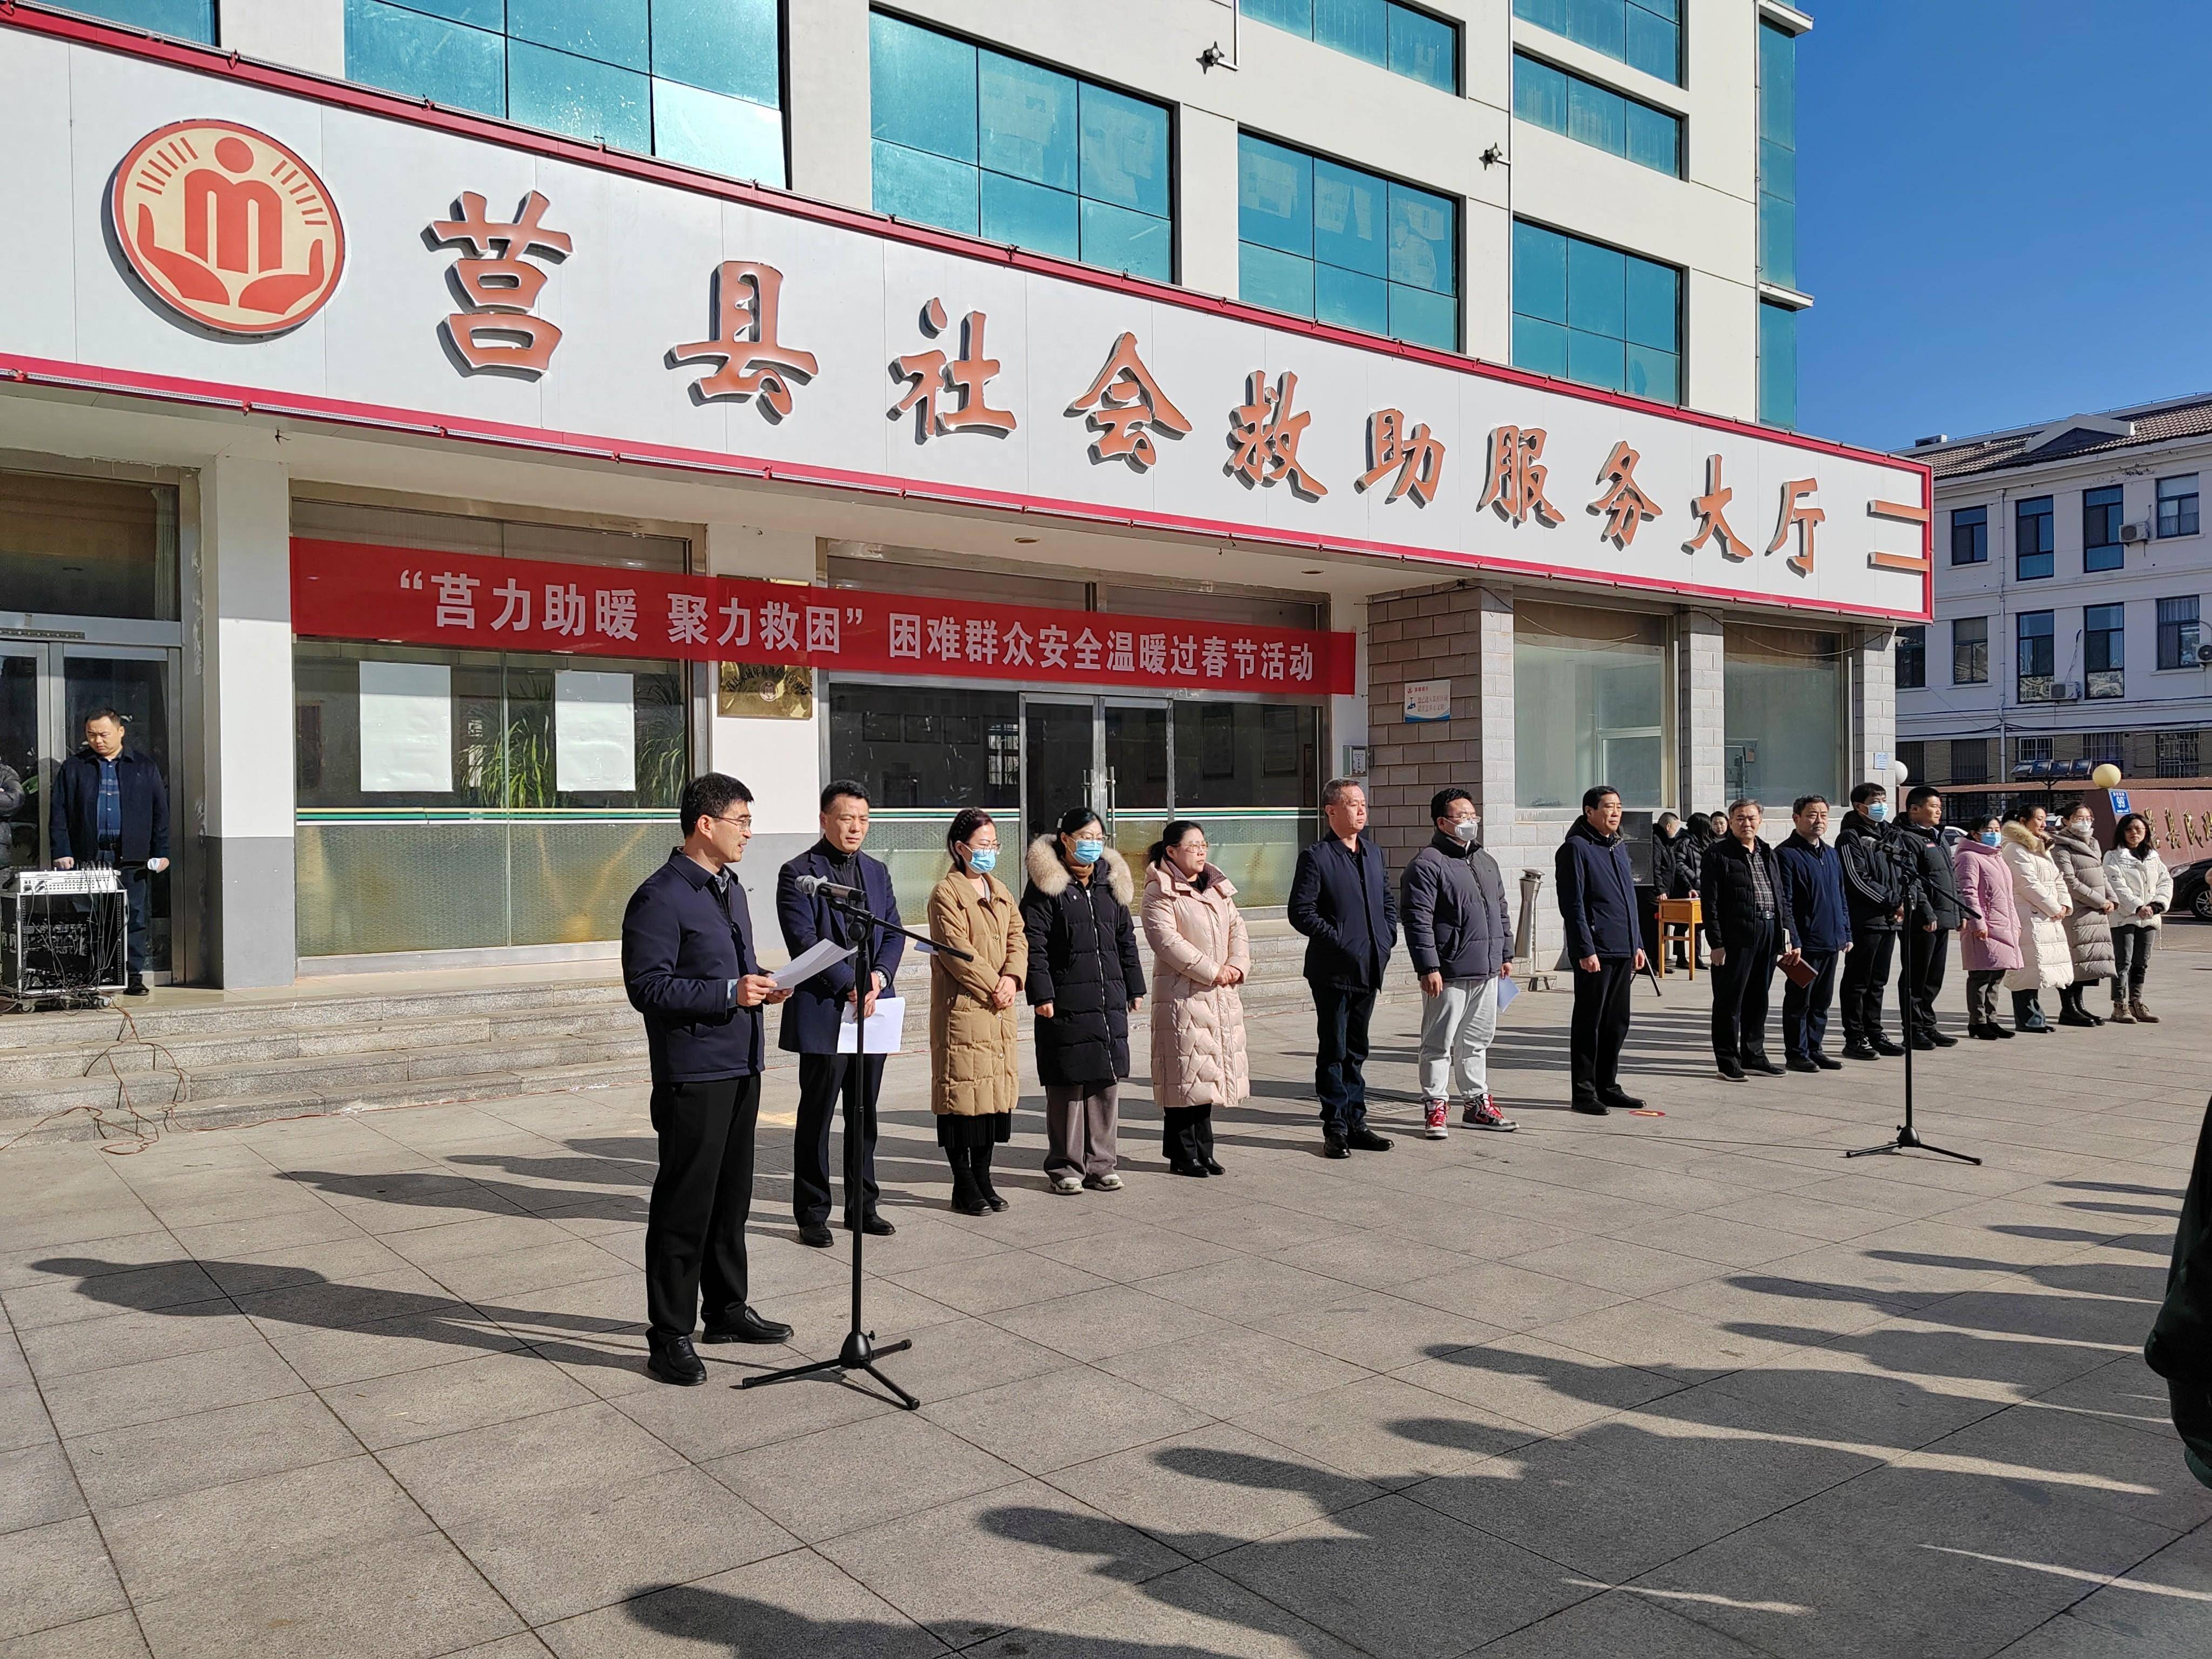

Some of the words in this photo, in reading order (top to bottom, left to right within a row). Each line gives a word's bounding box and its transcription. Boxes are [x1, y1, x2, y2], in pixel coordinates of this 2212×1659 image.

[424, 190, 1826, 576] 莒县社会救助服务大厅
[400, 569, 638, 642] “莒力助暖
[667, 594, 863, 653] 聚力救困”
[888, 612, 1314, 682] 困难群众安全温暖过春节活动
